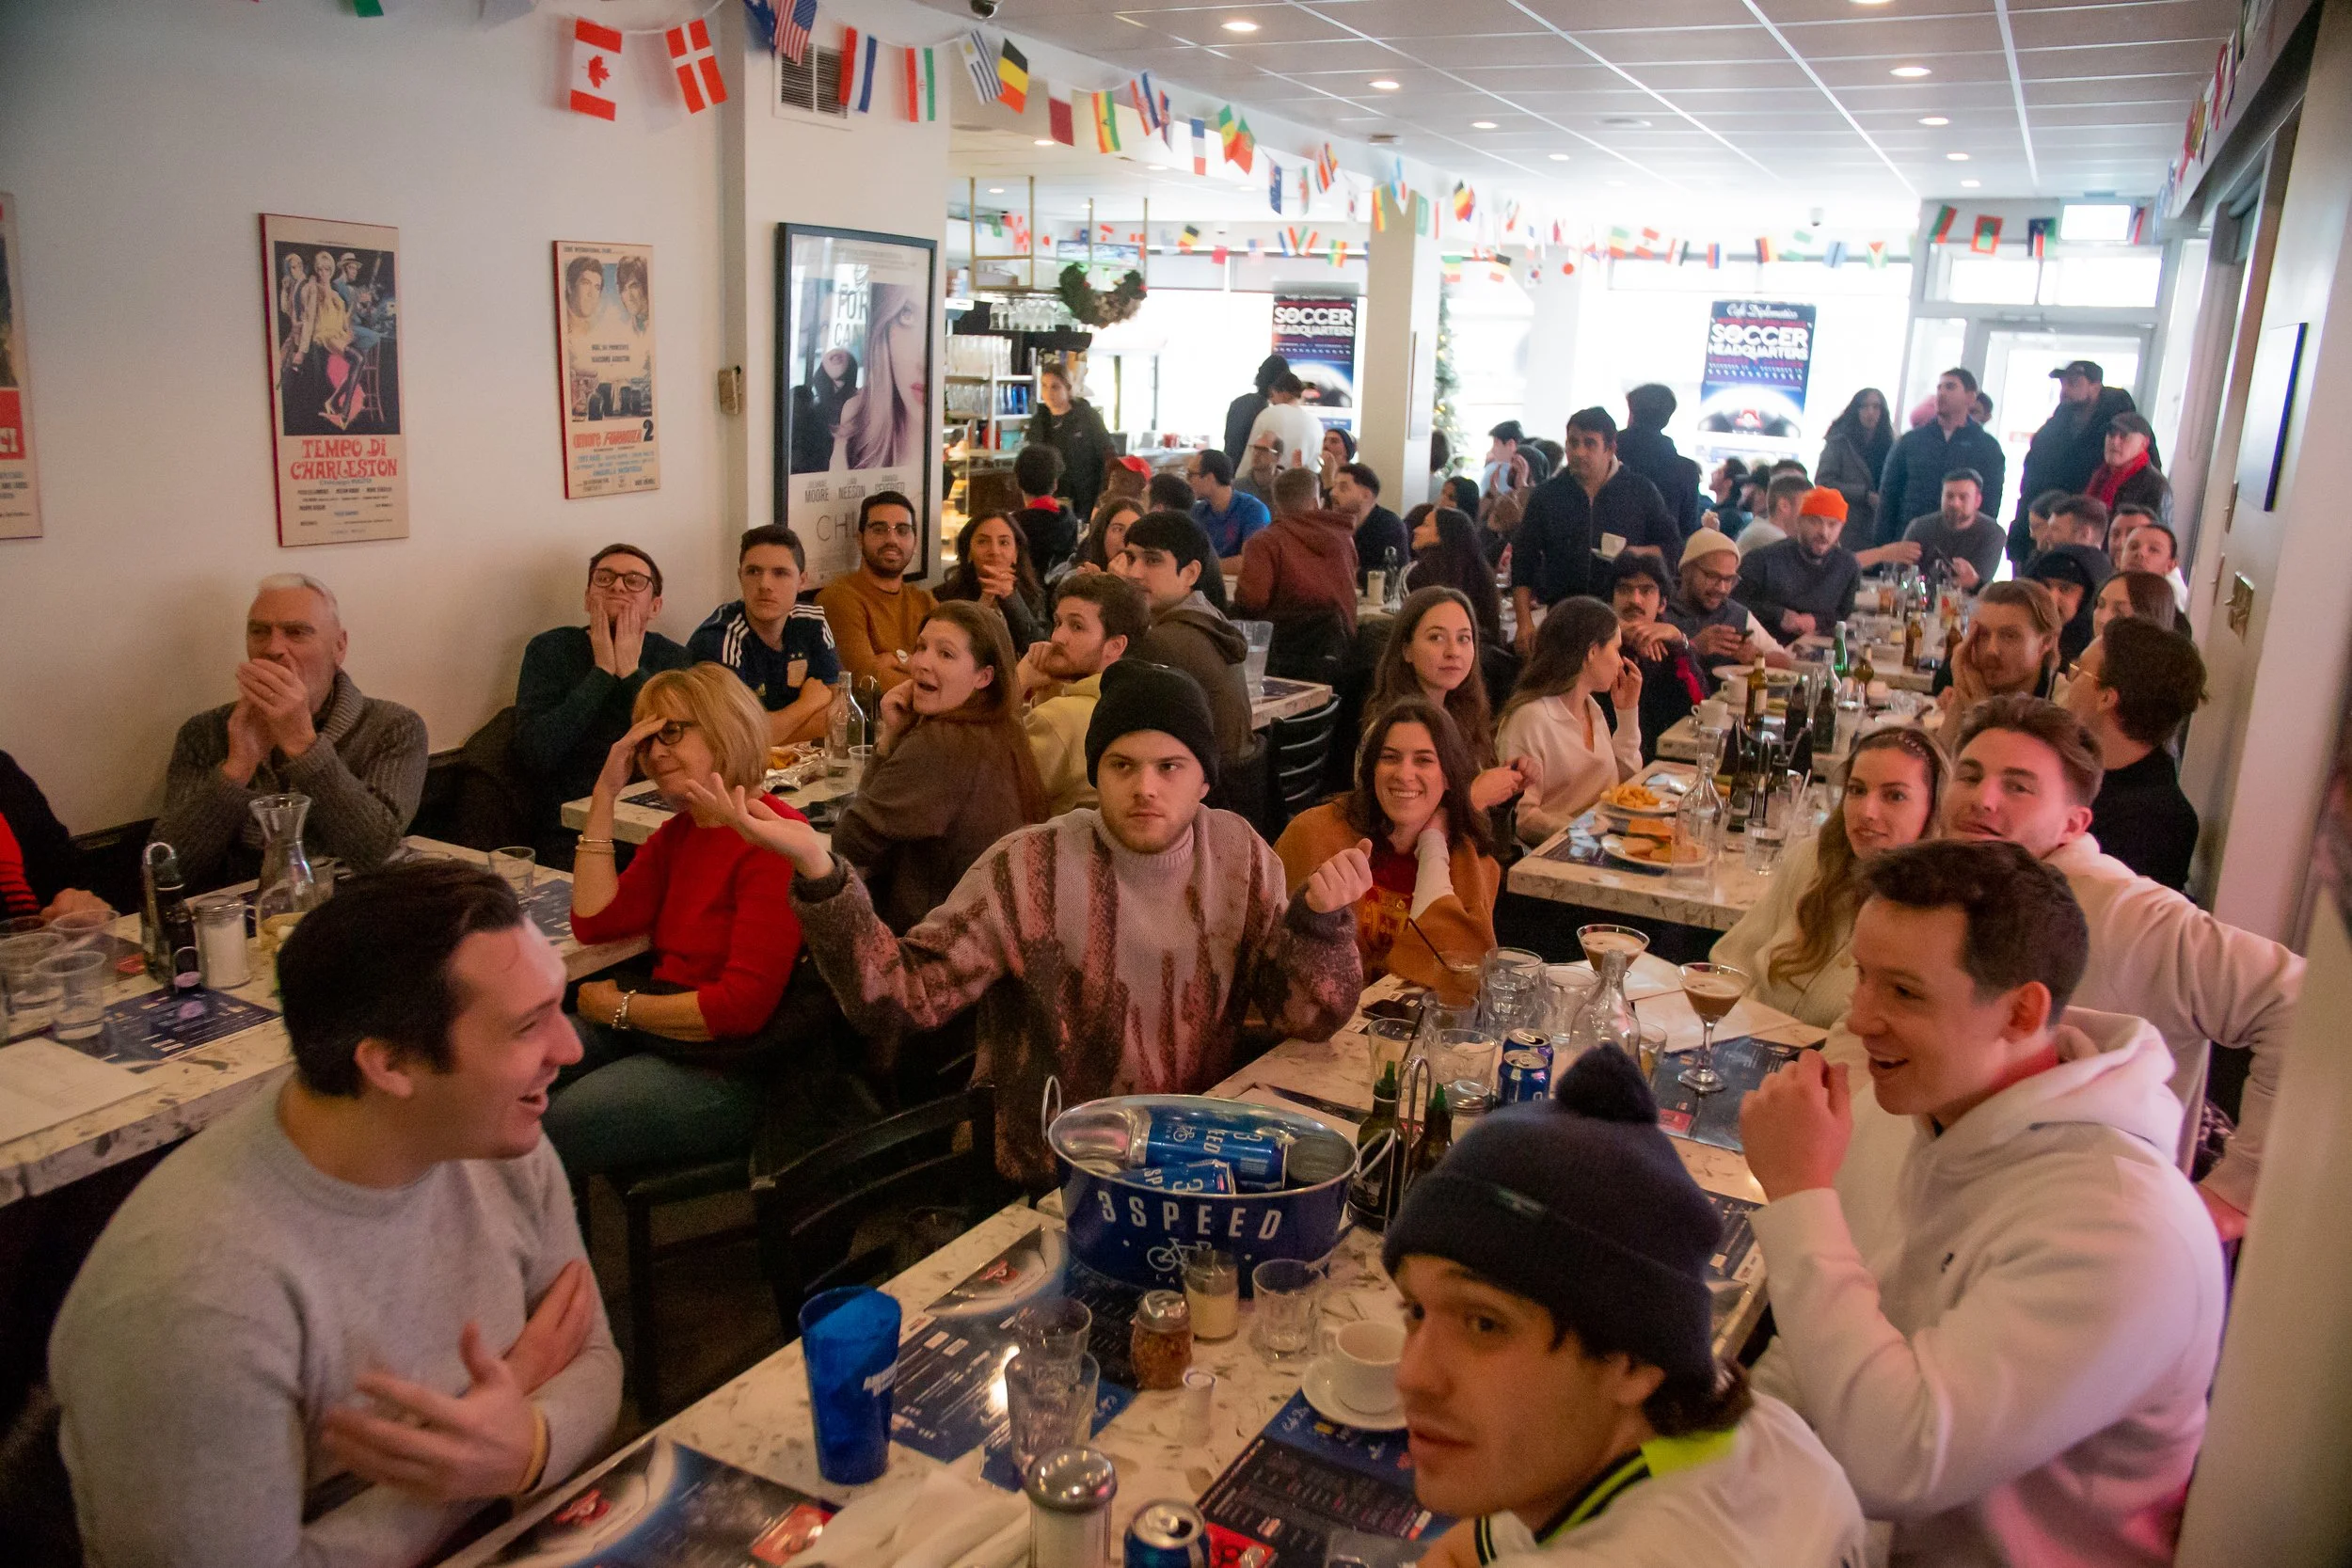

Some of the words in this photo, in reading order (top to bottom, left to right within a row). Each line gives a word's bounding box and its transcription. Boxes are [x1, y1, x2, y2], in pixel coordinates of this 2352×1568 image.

[1273, 307, 1354, 326] SOCCER
[1710, 324, 1809, 349] SOCCER
[1708, 342, 1809, 360] HEADQUARTERS
[643, 419, 655, 442] 2
[302, 438, 363, 459] TEMPO
[290, 458, 399, 481] CHARLESTON
